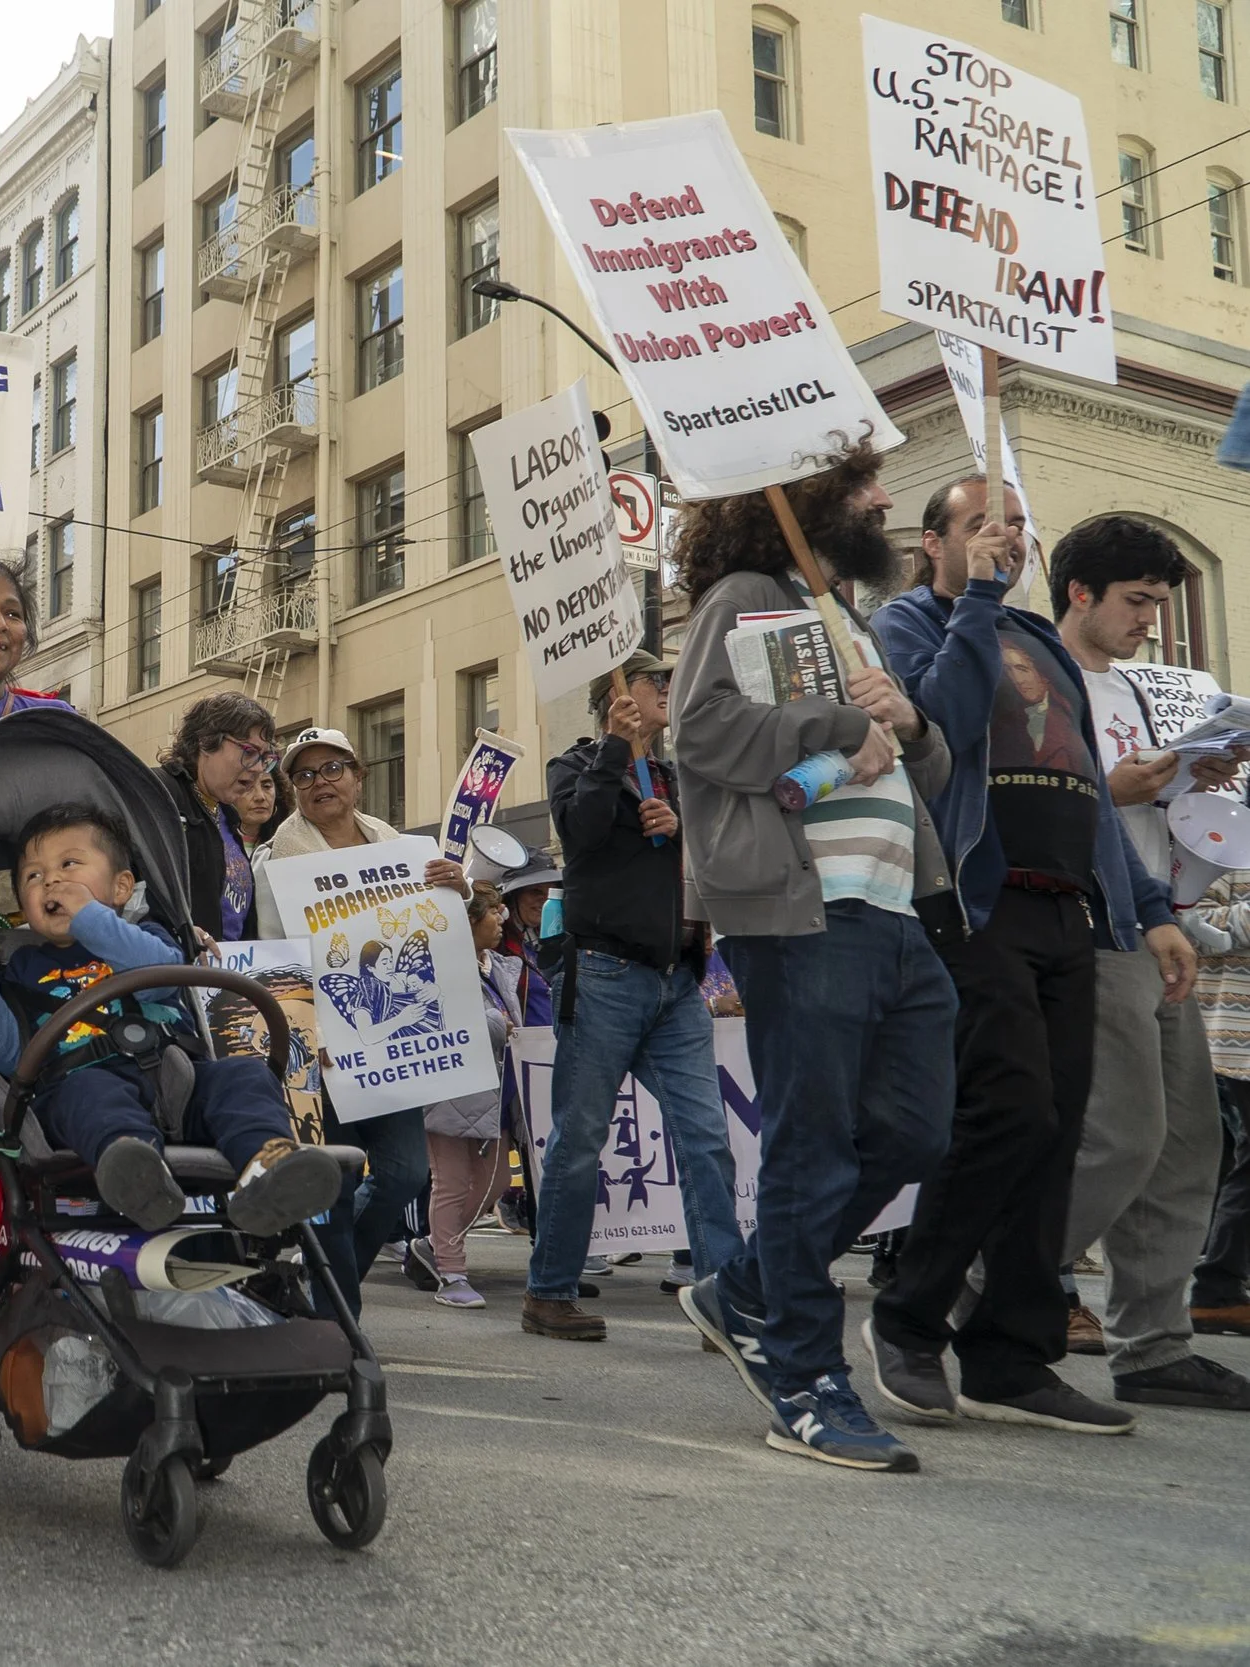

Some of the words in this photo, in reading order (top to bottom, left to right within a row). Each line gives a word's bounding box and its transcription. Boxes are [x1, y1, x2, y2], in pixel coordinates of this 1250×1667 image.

[925, 43, 1012, 97] STOP
[915, 117, 1085, 210] RAMPAGE!
[589, 184, 705, 227] Defend
[884, 171, 1018, 255] DEFEND
[582, 227, 757, 273] Immigrants
[646, 275, 728, 313] With
[995, 256, 1105, 324] IRAN!
[614, 330, 702, 363] Union
[699, 301, 817, 353] Power!
[908, 279, 1078, 353] SPARTACIST
[663, 379, 836, 436] Spartacist/ICL
[510, 550, 546, 585] the
[522, 605, 551, 643] NO
[543, 610, 619, 666] MEMBER
[809, 624, 836, 675] Defend
[224, 882, 247, 914] MUA
[314, 873, 349, 892] NO
[358, 863, 411, 885] MAS
[304, 881, 435, 934] DEPORTACIONES
[335, 1051, 368, 1071] WE
[387, 1029, 471, 1061] BELONG
[354, 1053, 465, 1089] TOGETHER
[604, 1226, 629, 1240] (415)
[631, 1223, 676, 1236] 621-8140
[791, 1411, 825, 1446] N
